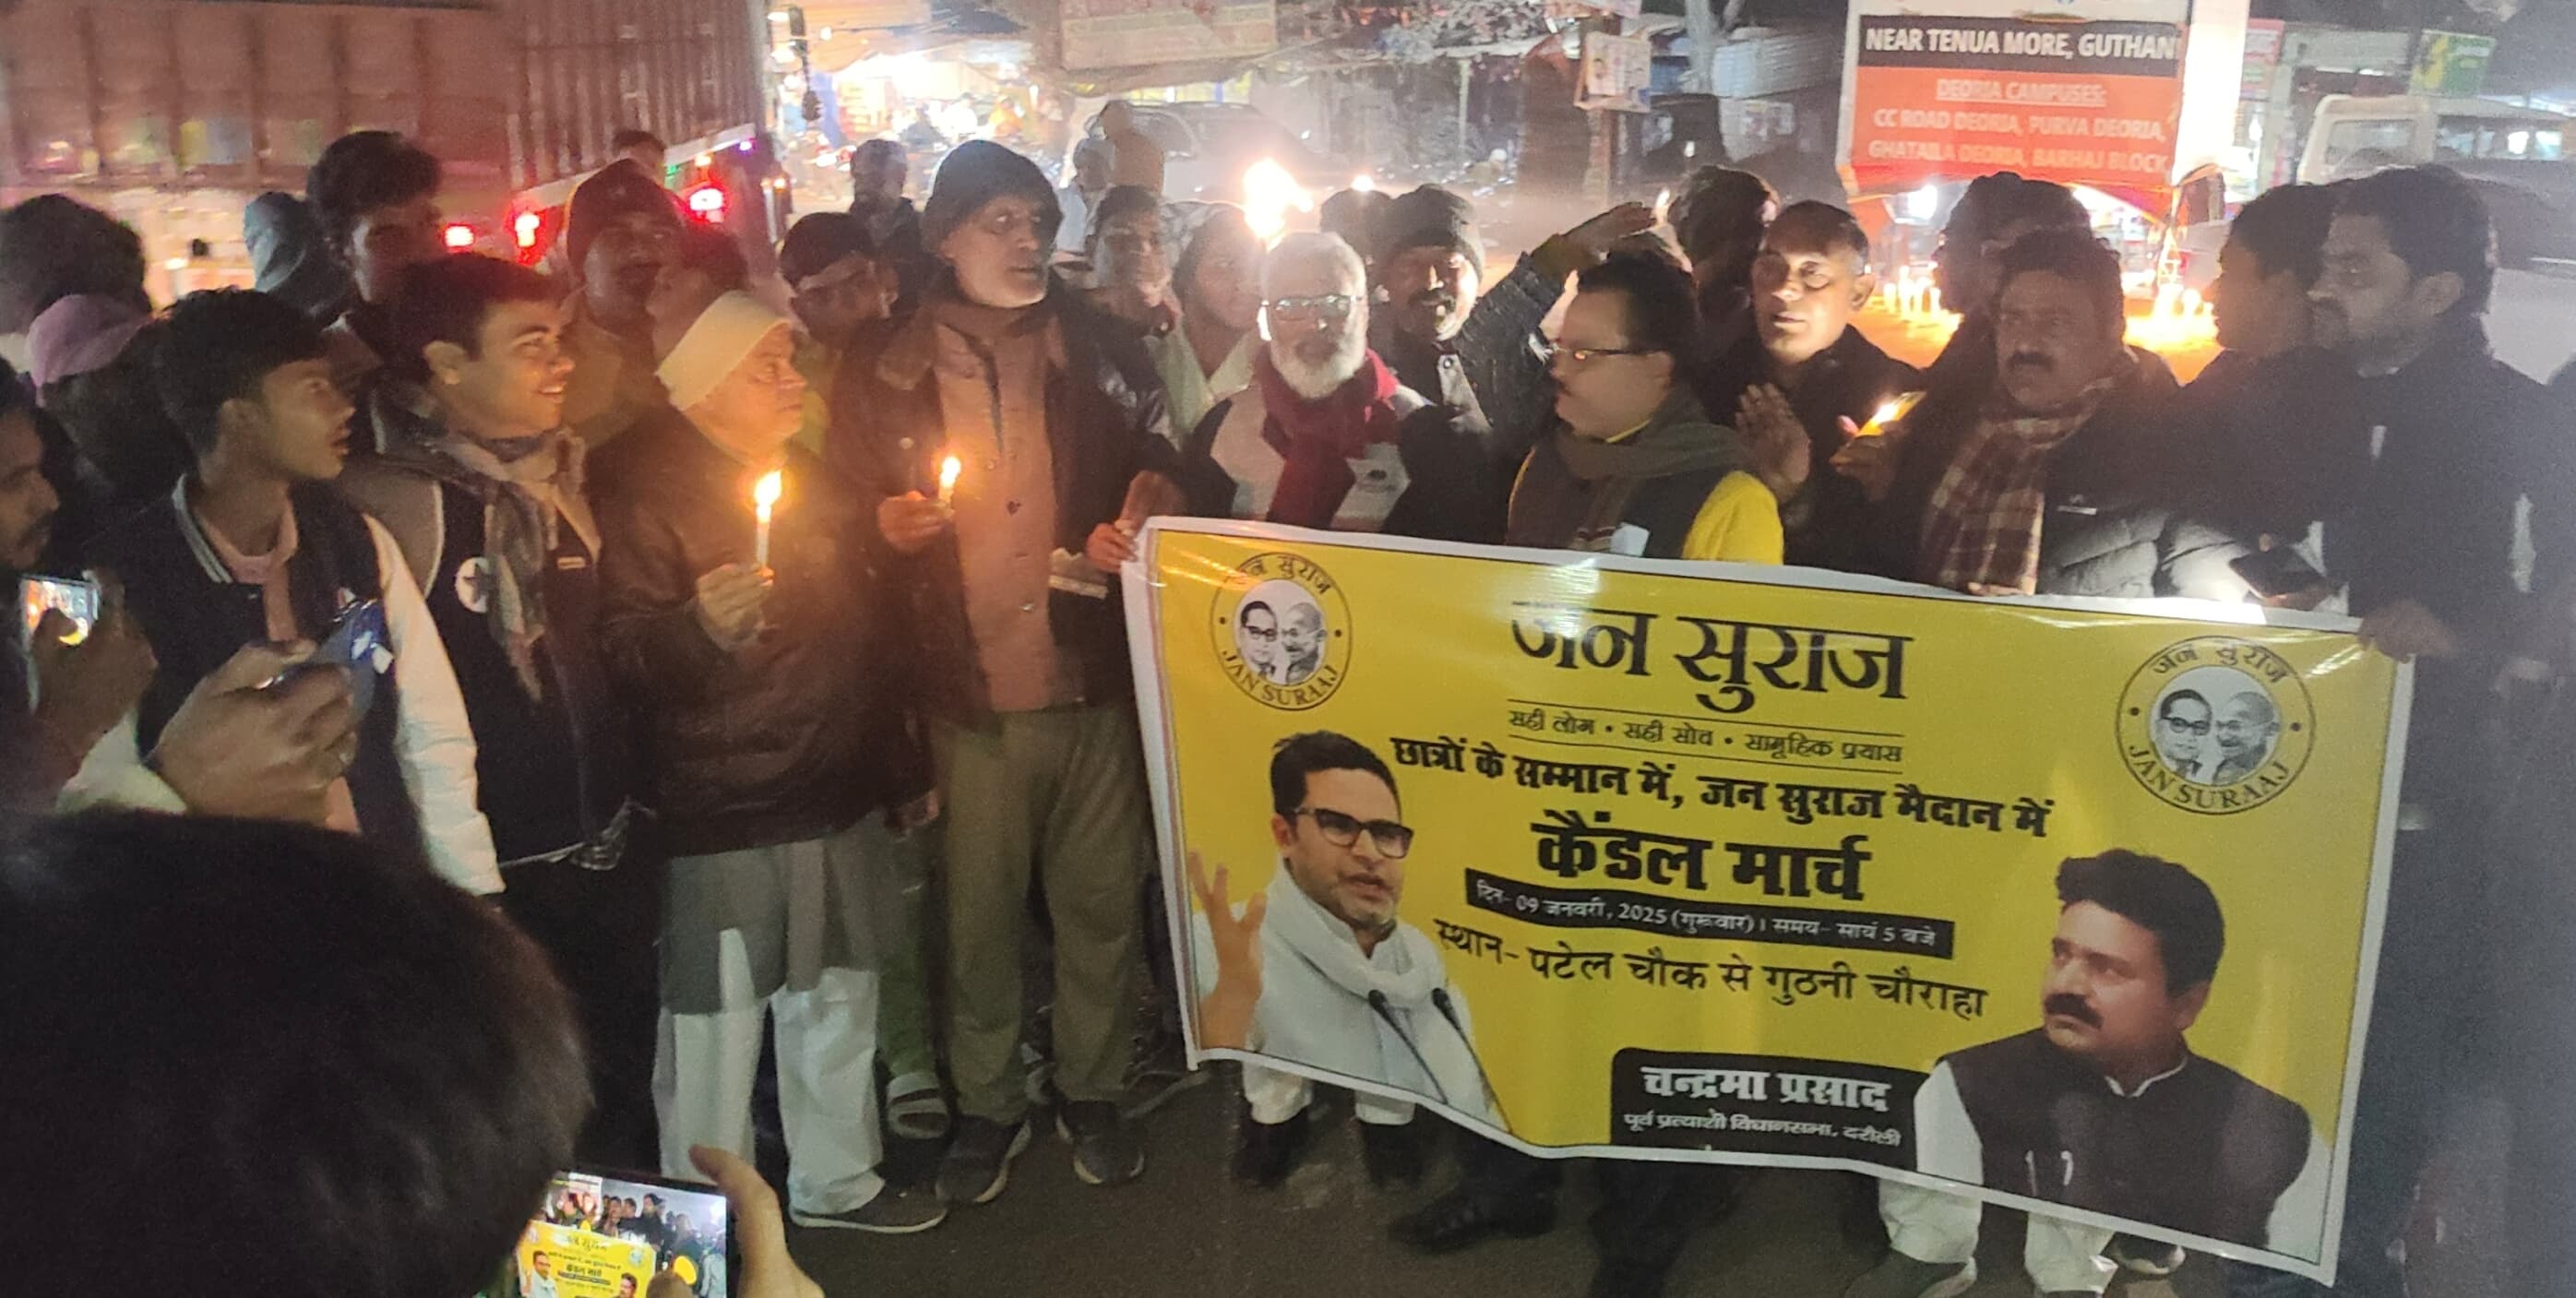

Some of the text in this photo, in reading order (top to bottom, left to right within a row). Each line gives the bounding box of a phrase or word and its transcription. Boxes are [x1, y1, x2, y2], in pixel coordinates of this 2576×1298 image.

[1866, 29, 1923, 52] NEAR
[1927, 30, 1999, 54] TENUA
[2004, 31, 2073, 59] MORE,
[1938, 79, 2001, 99] DEORIA
[1874, 109, 2165, 142] CC ROAD DEORIA, PURVA DEORIA,
[2107, 151, 2168, 173] BLOCK
[1222, 650, 1338, 706] JAN SURAAJ
[1511, 601, 1914, 714] जन सुराज
[2152, 643, 2290, 683] जन सुराज
[1509, 709, 1902, 762] सही लोग सही सोच सामूहिक प्रयास
[1390, 736, 2055, 837] छात्रों के सम्मान में, जन सुराज मैदान में
[2129, 745, 2288, 808] JAN SURAAJ
[1531, 809, 1872, 900] कैंडल मार्च
[1516, 895, 1539, 913] 09
[1542, 897, 1613, 920] जनवरी,
[1618, 902, 1667, 924] 2025
[1882, 928, 1895, 942] 5
[1899, 925, 1937, 947] बजे
[1433, 918, 1989, 1021] स्थान- पटेल चौक से गुठनी चौराहा
[1640, 1066, 1892, 1112] चन्द्रमा प्रसाद
[1623, 1110, 1653, 1132] पूर्व
